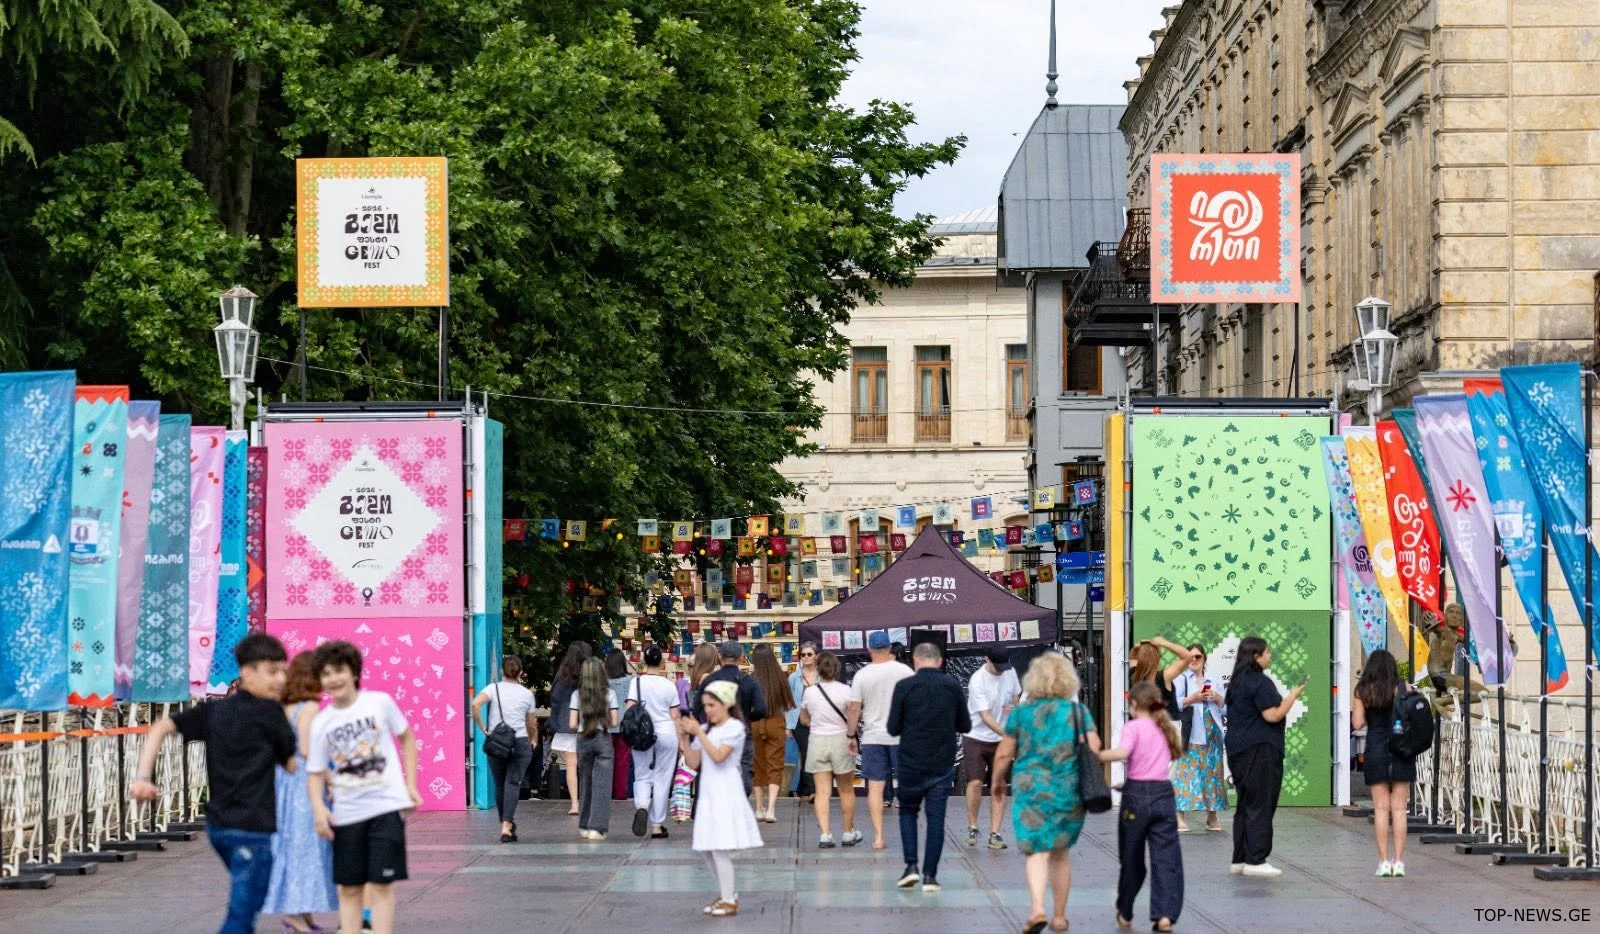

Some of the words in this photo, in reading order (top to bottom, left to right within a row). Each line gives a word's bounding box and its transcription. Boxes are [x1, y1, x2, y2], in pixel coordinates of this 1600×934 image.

[346, 246, 399, 260] GEMO
[341, 526, 393, 540] GEMO
[358, 541, 375, 549] FEST
